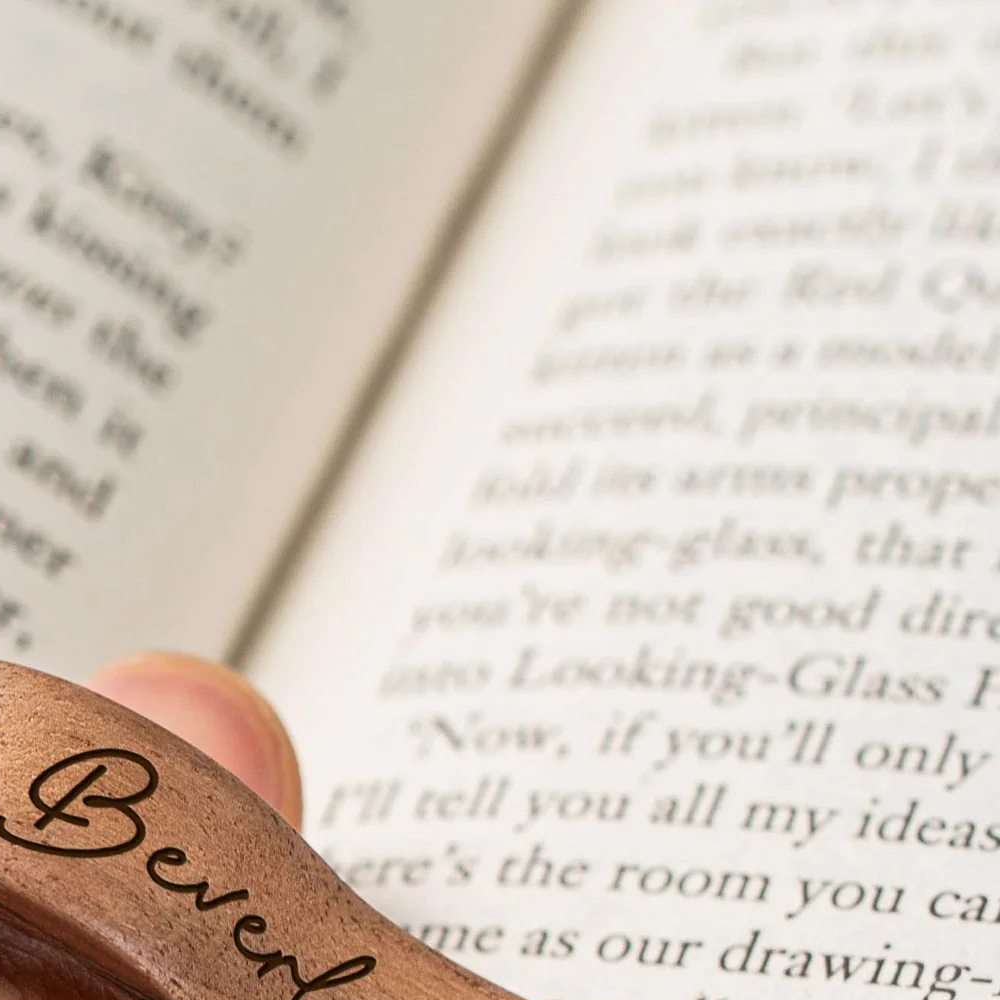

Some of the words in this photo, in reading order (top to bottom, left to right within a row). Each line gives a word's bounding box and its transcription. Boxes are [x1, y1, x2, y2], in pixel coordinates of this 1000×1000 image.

[598, 716, 652, 756] if
[855, 734, 987, 790] only
[513, 789, 633, 836] you
[651, 784, 726, 827] all
[743, 804, 834, 847] my
[498, 845, 589, 887] the
[612, 865, 770, 901] room
[787, 880, 904, 919] you
[929, 893, 1000, 923] ca
[521, 930, 574, 955] as
[597, 938, 702, 966] our
